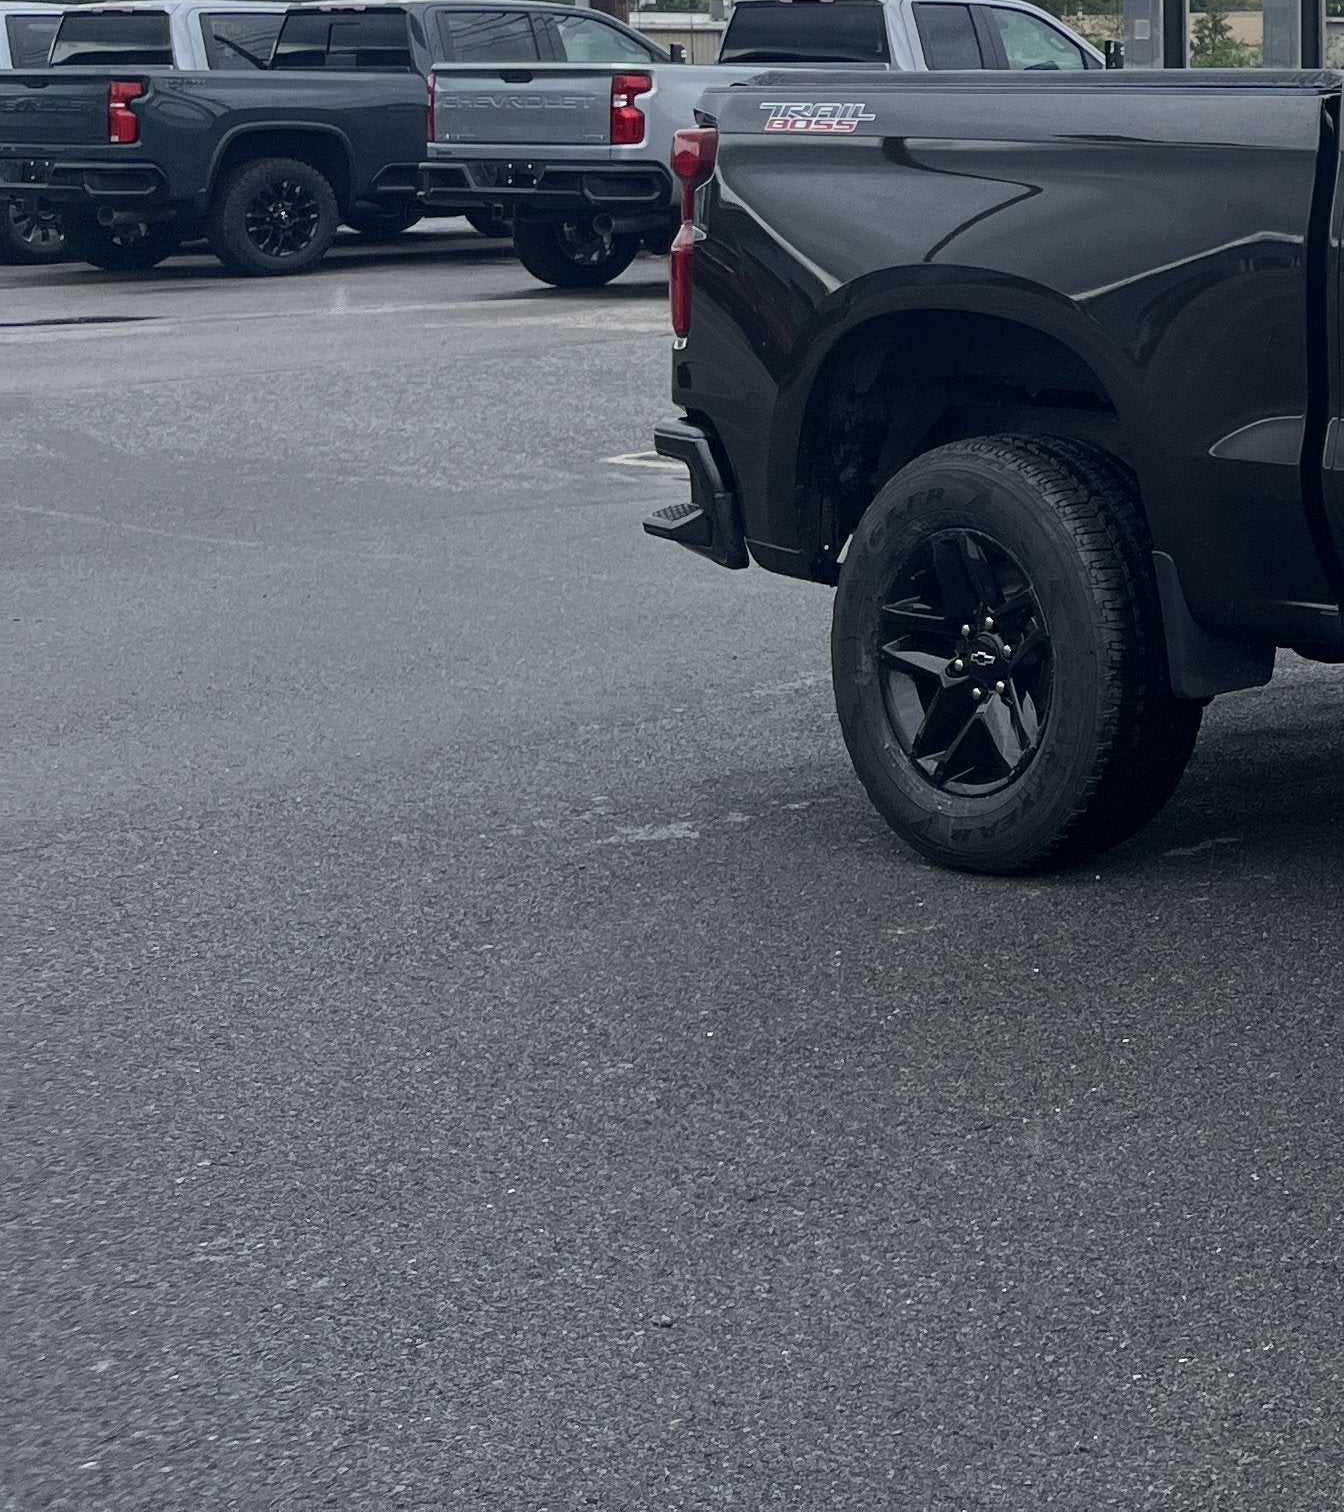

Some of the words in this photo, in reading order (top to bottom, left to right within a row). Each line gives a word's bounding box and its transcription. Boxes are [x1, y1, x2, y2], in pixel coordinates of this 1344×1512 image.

[441, 94, 598, 111] CHEVROLET
[759, 101, 877, 122] TRAIL
[764, 118, 860, 133] BOSS
